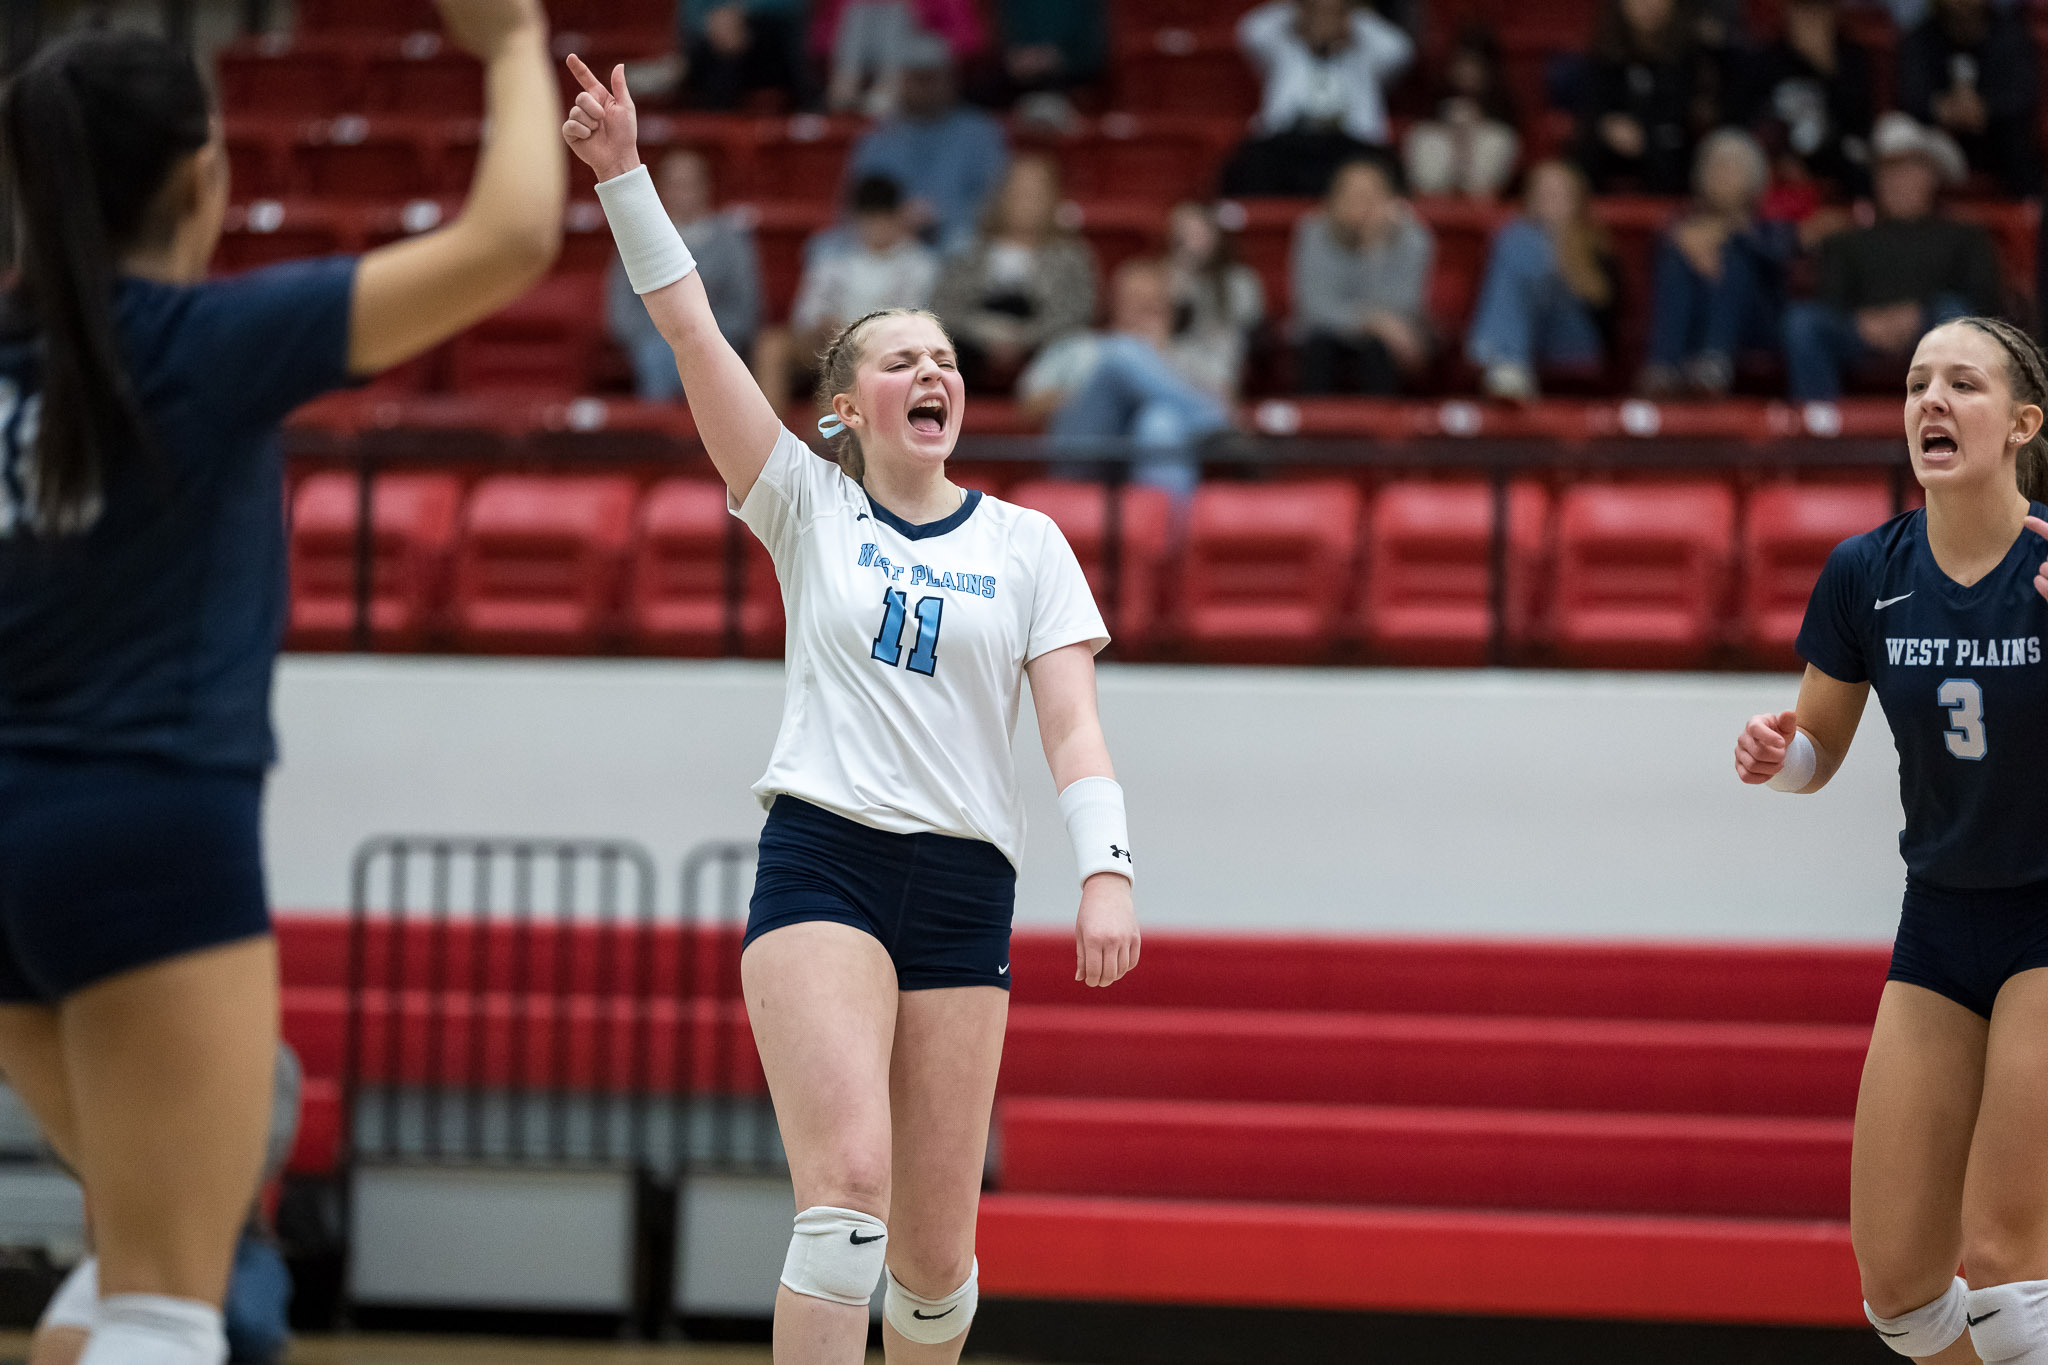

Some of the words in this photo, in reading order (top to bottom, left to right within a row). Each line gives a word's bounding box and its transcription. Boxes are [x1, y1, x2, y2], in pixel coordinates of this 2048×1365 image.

[911, 565, 996, 598] PLAINS
[871, 586, 944, 677] 11
[1885, 638, 1950, 666] WEST
[1955, 636, 2041, 666] PLAINS
[1937, 678, 1988, 761] 3
